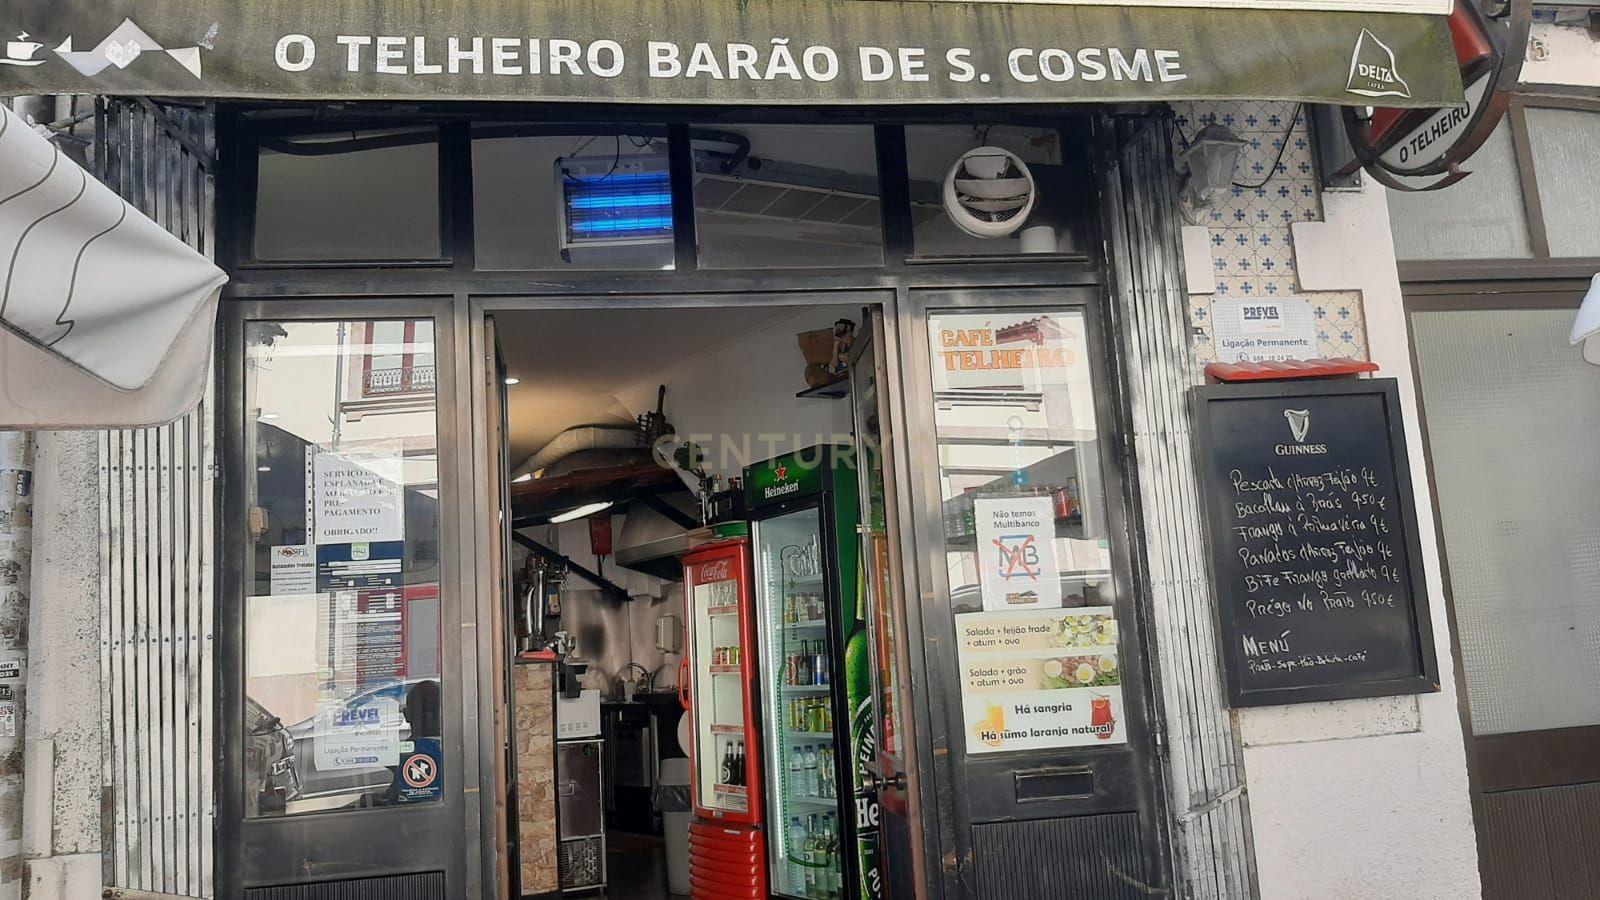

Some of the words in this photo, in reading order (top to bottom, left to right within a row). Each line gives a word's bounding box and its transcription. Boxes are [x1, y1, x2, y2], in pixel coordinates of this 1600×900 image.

[274, 34, 316, 72] O
[336, 34, 626, 78] TELHEIRO
[647, 36, 840, 82] BARÃO
[858, 46, 930, 82] DE
[945, 47, 991, 83] S.
[1007, 47, 1188, 83] COSME
[1359, 64, 1394, 82] DELTA
[1399, 146, 1409, 163] O
[1410, 100, 1471, 155] TELHEIRO
[1222, 338, 1255, 349] Ligação
[1256, 338, 1308, 347] Permanente
[939, 348, 1075, 370] TELHEIRO
[1275, 443, 1327, 456] GUINNESS
[764, 482, 799, 499] Heineken
[324, 508, 381, 517] PAGAMENTO
[993, 510, 1009, 518] Não
[993, 520, 1040, 529] Multibanco
[323, 527, 378, 537] OBRIGADO!!
[966, 628, 995, 637] Salada
[1003, 626, 1026, 635] feijão
[1028, 625, 1051, 634] frade
[973, 639, 996, 647] atum
[1005, 638, 1020, 646] ovo
[969, 669, 999, 678] Salada
[1007, 667, 1027, 677] grão
[977, 679, 1000, 687] atum
[1015, 704, 1031, 715] Há
[1034, 703, 1072, 714] sangria
[981, 730, 997, 741] Há
[1030, 728, 1069, 738] laranja
[1072, 724, 1110, 735] natural
[324, 745, 349, 755] Ligação
[350, 744, 389, 752] Permanente
